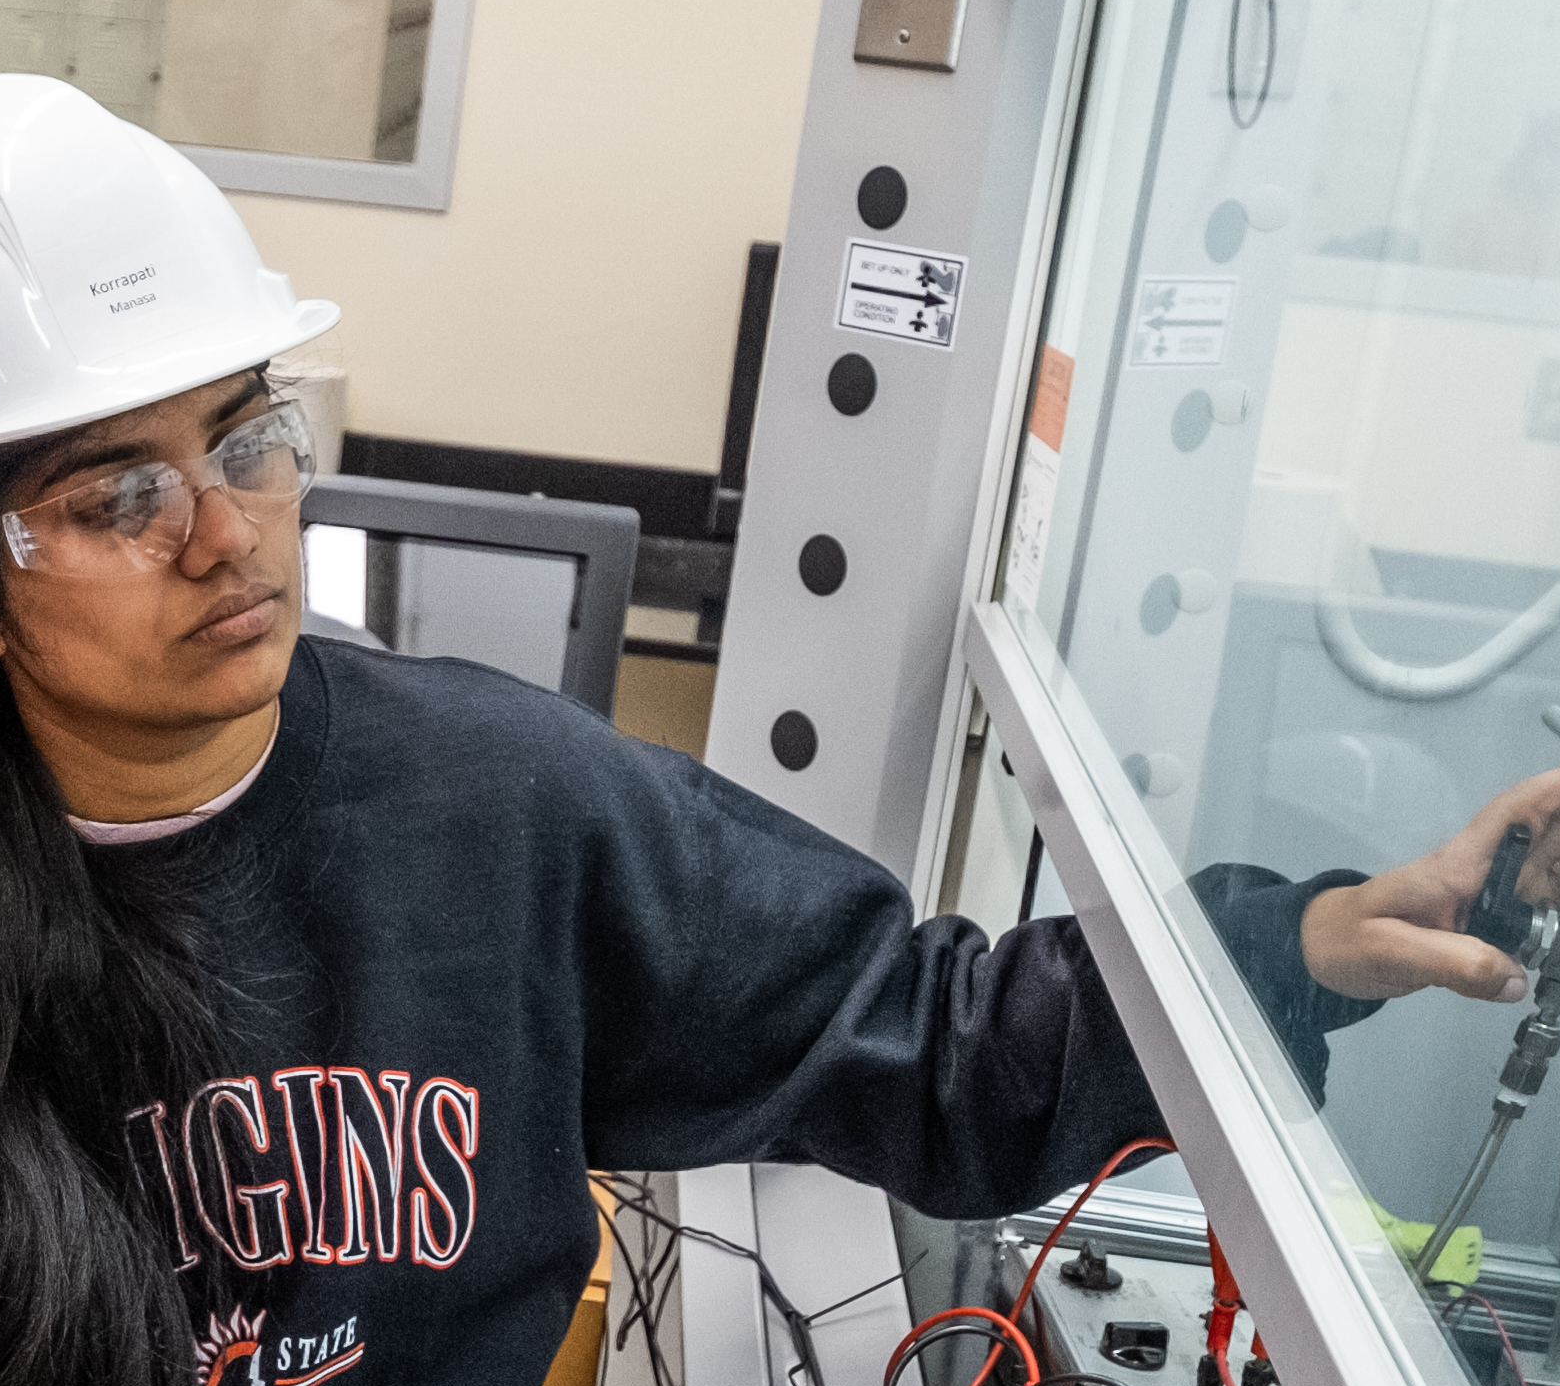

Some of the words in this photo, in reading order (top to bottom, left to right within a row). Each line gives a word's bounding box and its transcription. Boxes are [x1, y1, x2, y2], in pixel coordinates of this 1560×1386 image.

[89, 263, 157, 297] Korrapati
[109, 293, 157, 314] Manasa
[125, 1066, 480, 1273] IGINS
[277, 1315, 358, 1371] STATE
